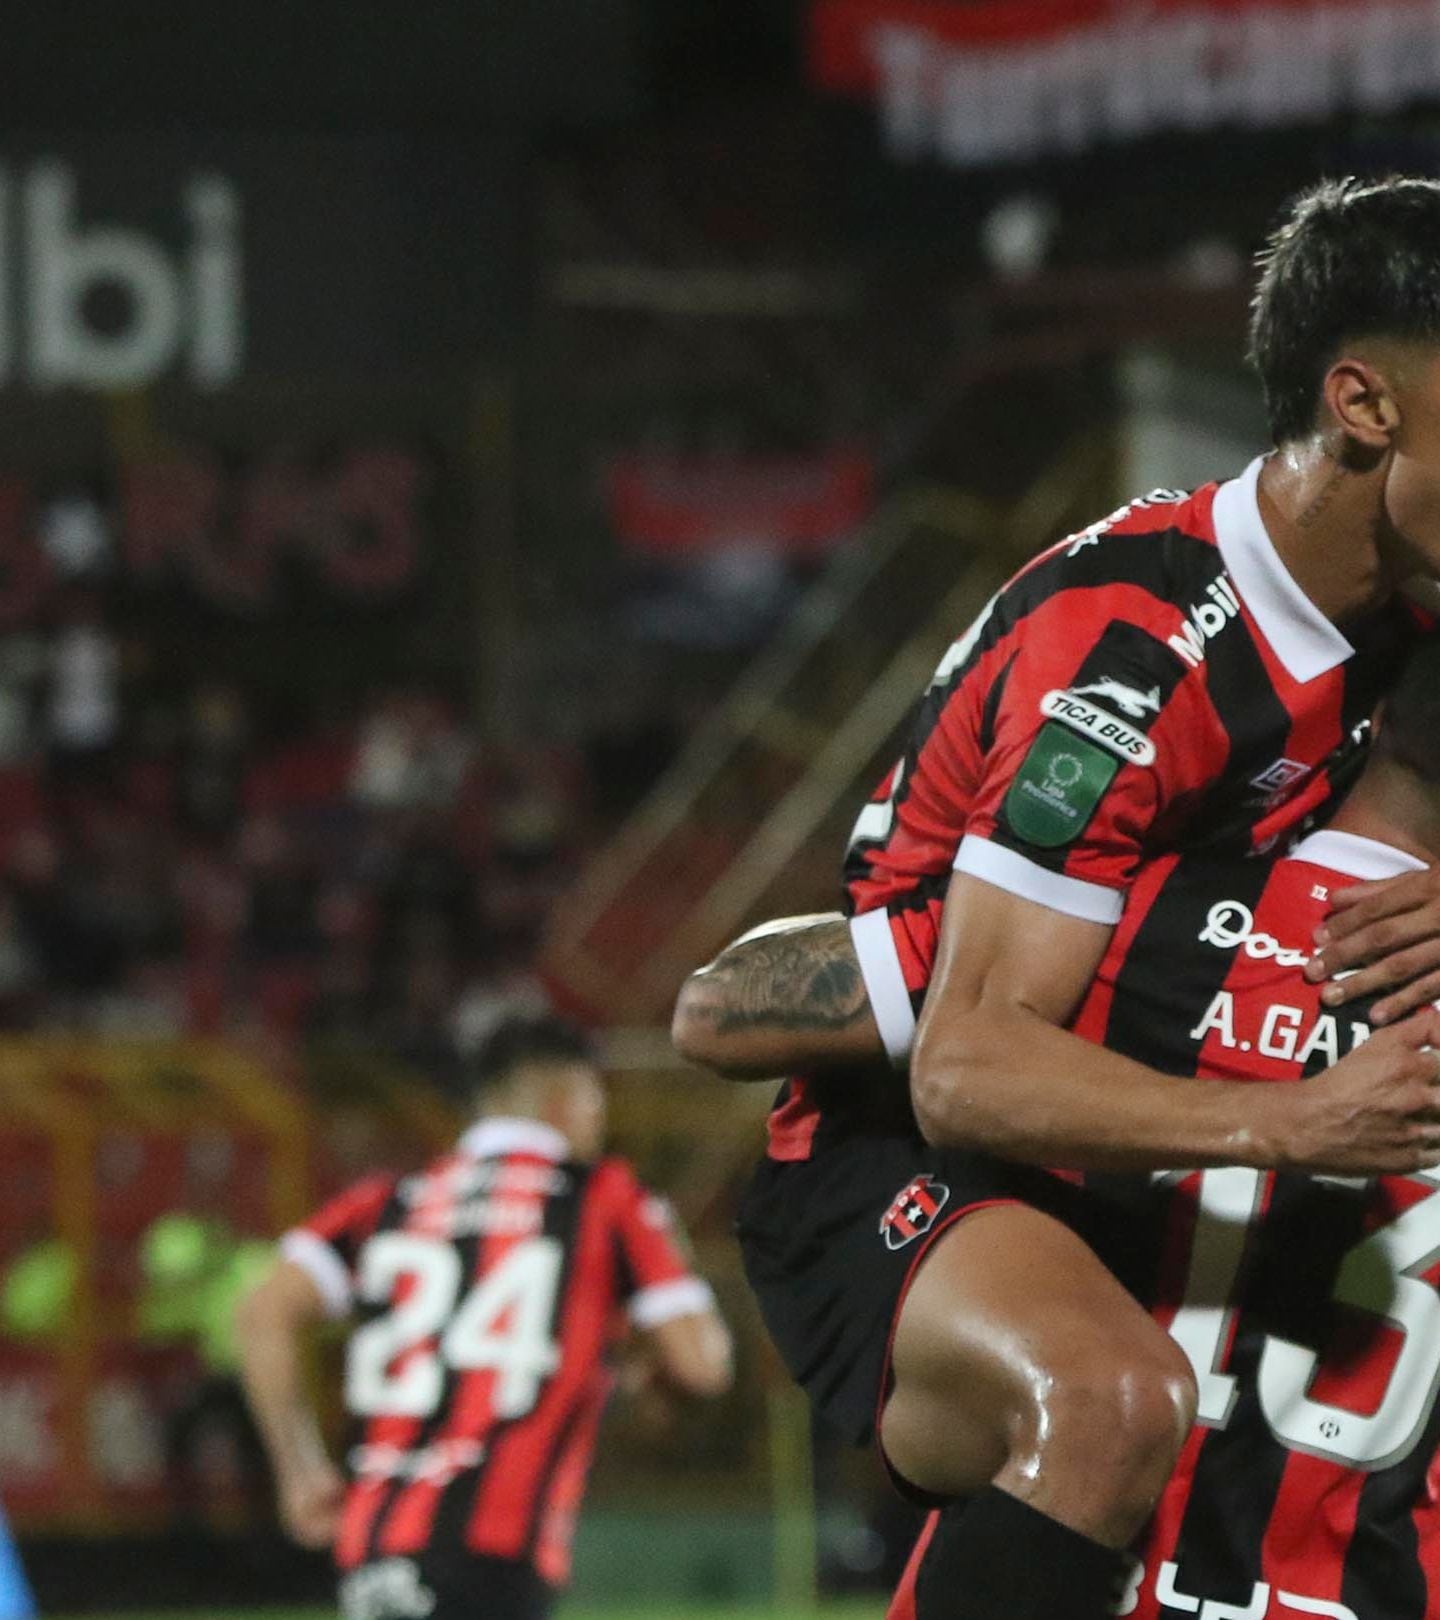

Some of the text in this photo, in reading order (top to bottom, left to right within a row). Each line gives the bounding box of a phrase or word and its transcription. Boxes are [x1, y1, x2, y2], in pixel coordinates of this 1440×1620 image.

[1051, 697, 1146, 755] TICA BUS
[1198, 900, 1310, 966] Dos
[345, 1231, 566, 1419] 24
